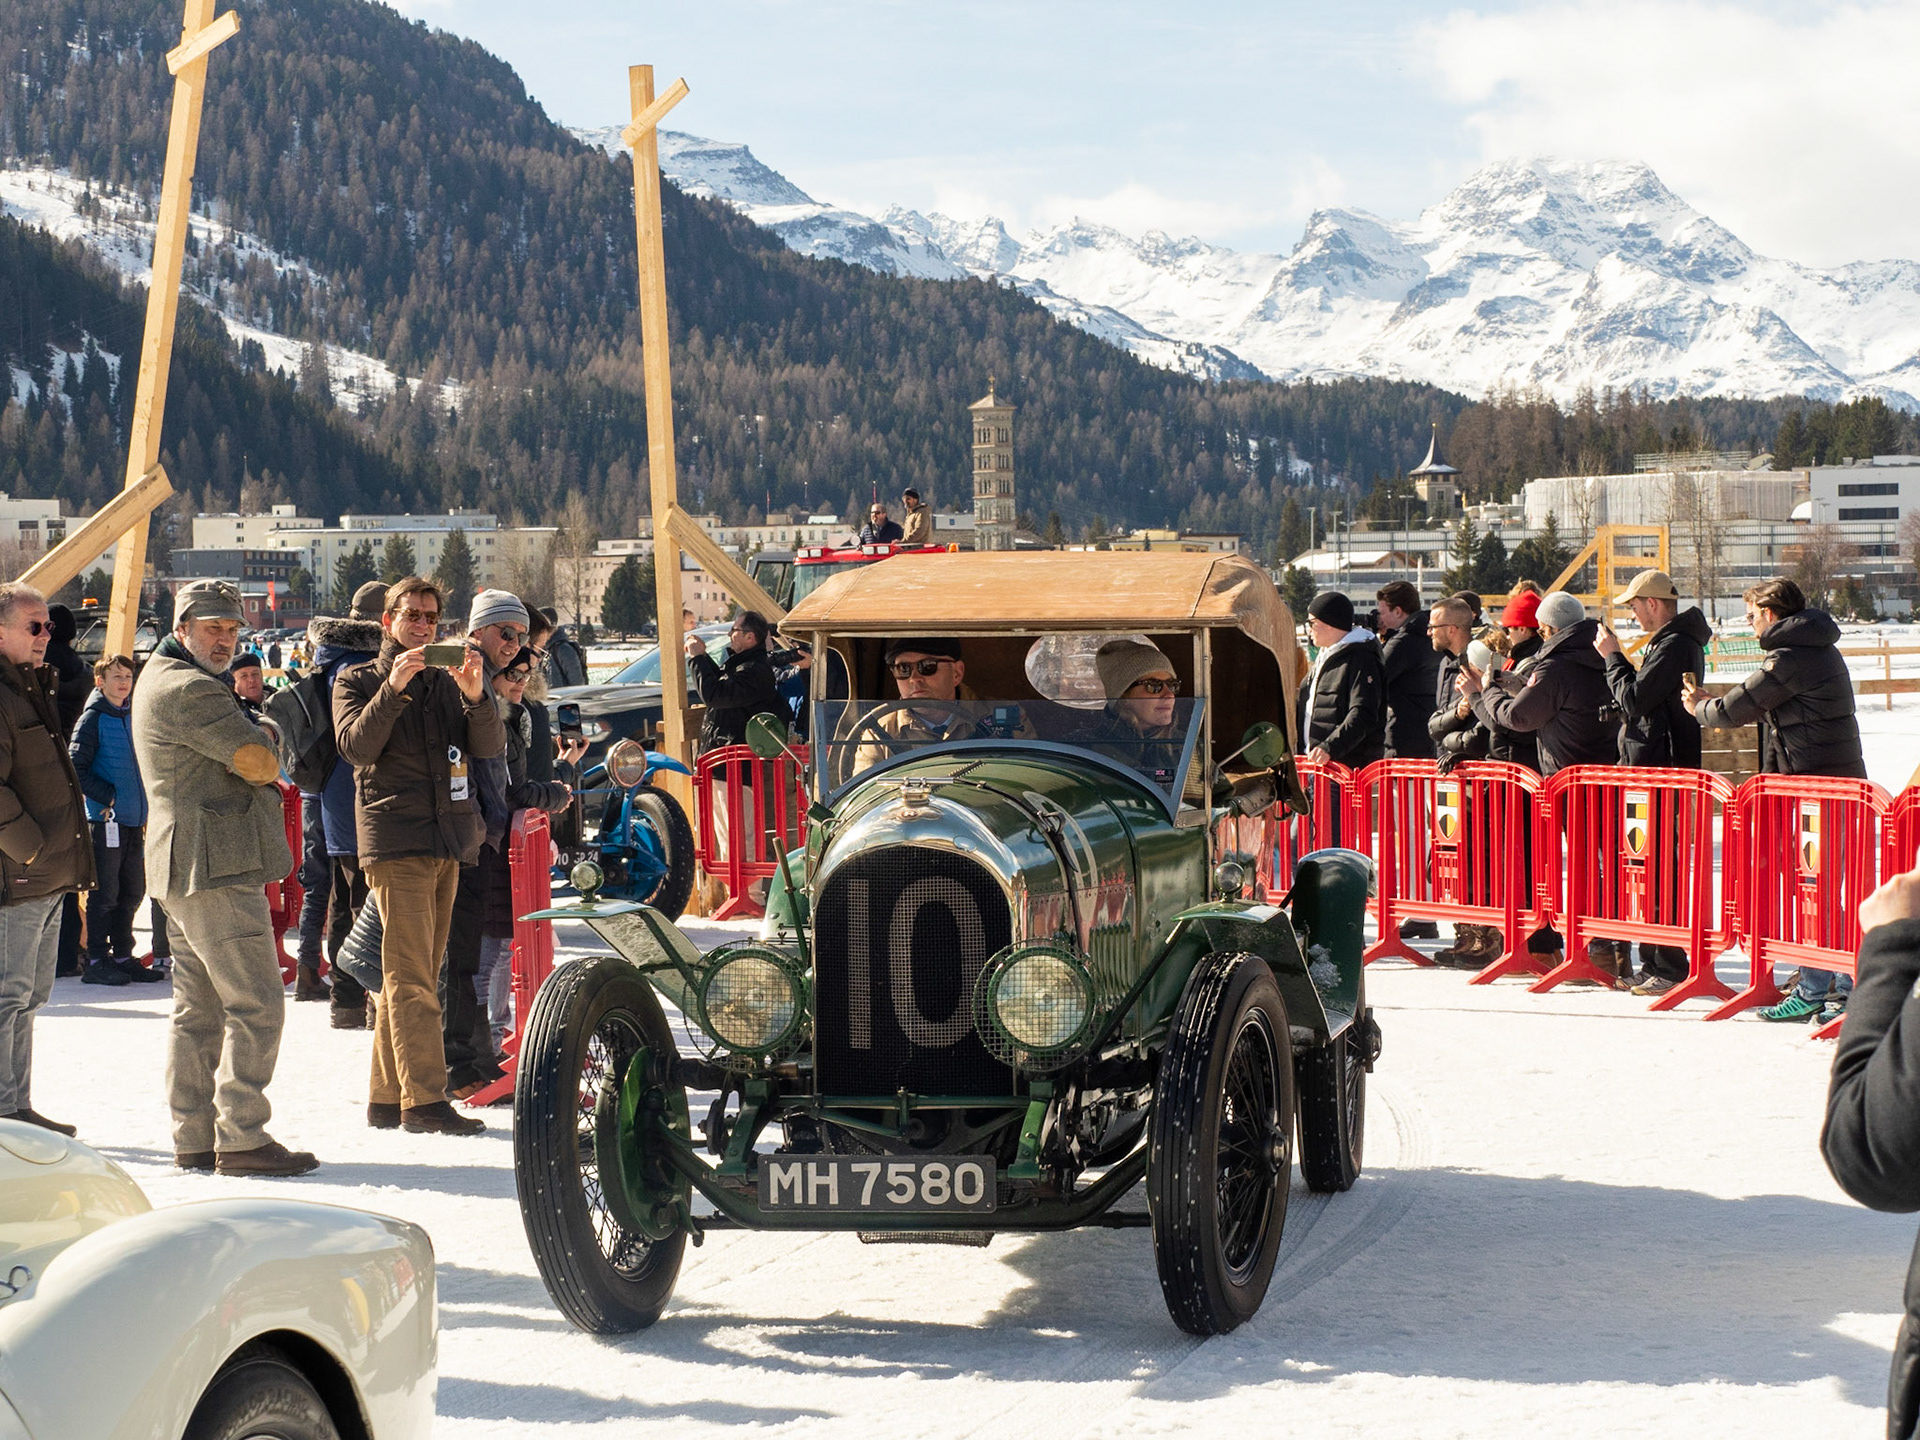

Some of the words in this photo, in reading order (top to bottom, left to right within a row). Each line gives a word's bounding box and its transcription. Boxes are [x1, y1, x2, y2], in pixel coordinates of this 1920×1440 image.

[587, 850, 599, 863] 24
[848, 876, 986, 1050] 10
[769, 1162, 839, 1205] MH
[851, 1162, 985, 1205] 7580
